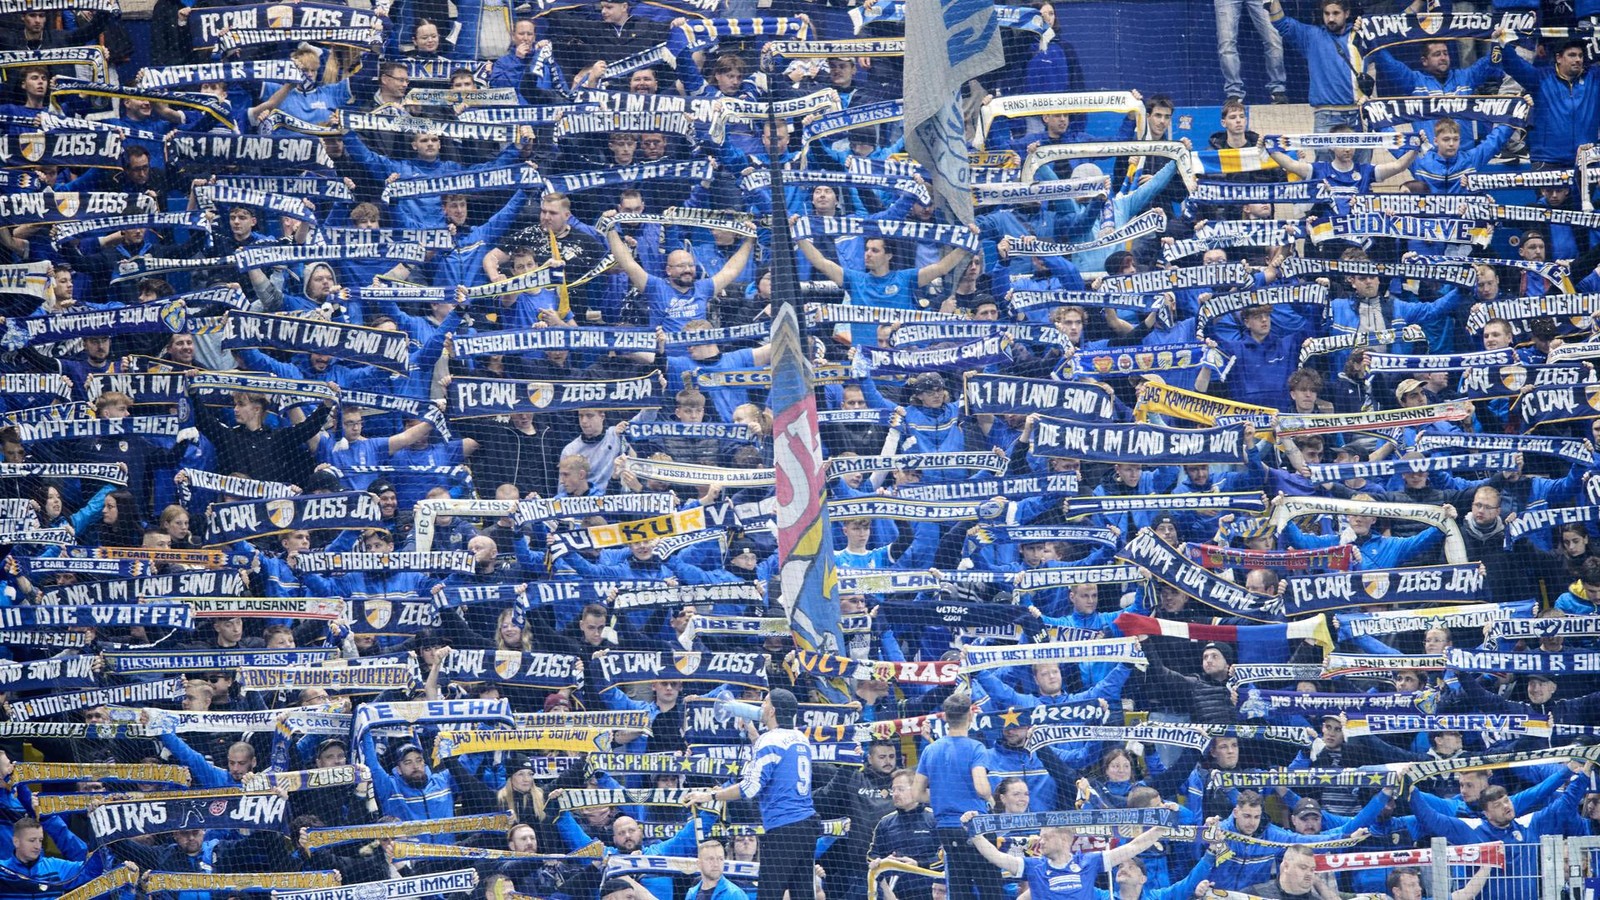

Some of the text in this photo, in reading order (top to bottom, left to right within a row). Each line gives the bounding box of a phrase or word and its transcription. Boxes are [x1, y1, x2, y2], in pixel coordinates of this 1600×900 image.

[201, 11, 219, 41] FC
[300, 8, 342, 27] ZEISS
[1450, 13, 1492, 29] ZEISS
[42, 48, 86, 61] ZEISS
[788, 40, 874, 53] CARL ZEISS
[465, 91, 510, 100] ZEISS JENA
[1105, 95, 1126, 105] JENA
[1313, 137, 1333, 145] CARL
[1336, 136, 1358, 144] ZEISS
[1361, 136, 1383, 144] JENA
[564, 171, 605, 191] DIE
[1002, 188, 1036, 199] CARL
[1038, 185, 1070, 195] ZEISS
[824, 217, 863, 235] DIE
[1330, 215, 1475, 243] SÜDKURVE
[345, 242, 382, 259] CARL
[372, 288, 392, 298] CARL
[394, 288, 419, 298] ZEISS
[26, 317, 46, 337] DAS
[569, 329, 608, 348] CARL
[613, 331, 657, 350] ZEISS
[1370, 352, 1508, 369] ALLE ZEISS
[246, 379, 297, 392] ZEISS
[561, 383, 605, 403] ZEISS
[1064, 387, 1099, 414] SIND
[831, 411, 855, 421] ZEISS
[1308, 407, 1435, 428] JENA ET LAUSANNE
[644, 424, 724, 438] CARL ZEISS
[1104, 429, 1239, 458] IM LAND SIND WIR
[727, 471, 750, 482] CARL
[1354, 461, 1395, 478] DIE
[1003, 478, 1041, 494] CARL
[302, 497, 347, 521] ZEISS
[875, 502, 977, 518] ZEISS JENA
[154, 551, 182, 562] ZEISS
[44, 561, 65, 570] CARL
[67, 561, 91, 570] ZEISS
[1175, 566, 1209, 598] FÜR
[1291, 577, 1314, 609] FC
[1397, 570, 1443, 593] ZEISS
[538, 582, 581, 602] DIE
[216, 600, 306, 612] ET LAUSANNE
[36, 606, 77, 625] DIE
[253, 653, 288, 666] ZEISS
[525, 651, 570, 679] ZEISS
[706, 653, 755, 674] ZEISS
[1389, 658, 1408, 668] ET
[1365, 713, 1529, 733] SÜDKURVE
[1124, 726, 1154, 739] FÜR
[307, 767, 355, 787] ZEISS
[796, 755, 812, 796] 9
[229, 795, 287, 825] JENA
[387, 873, 474, 897] FÜR IMMER
